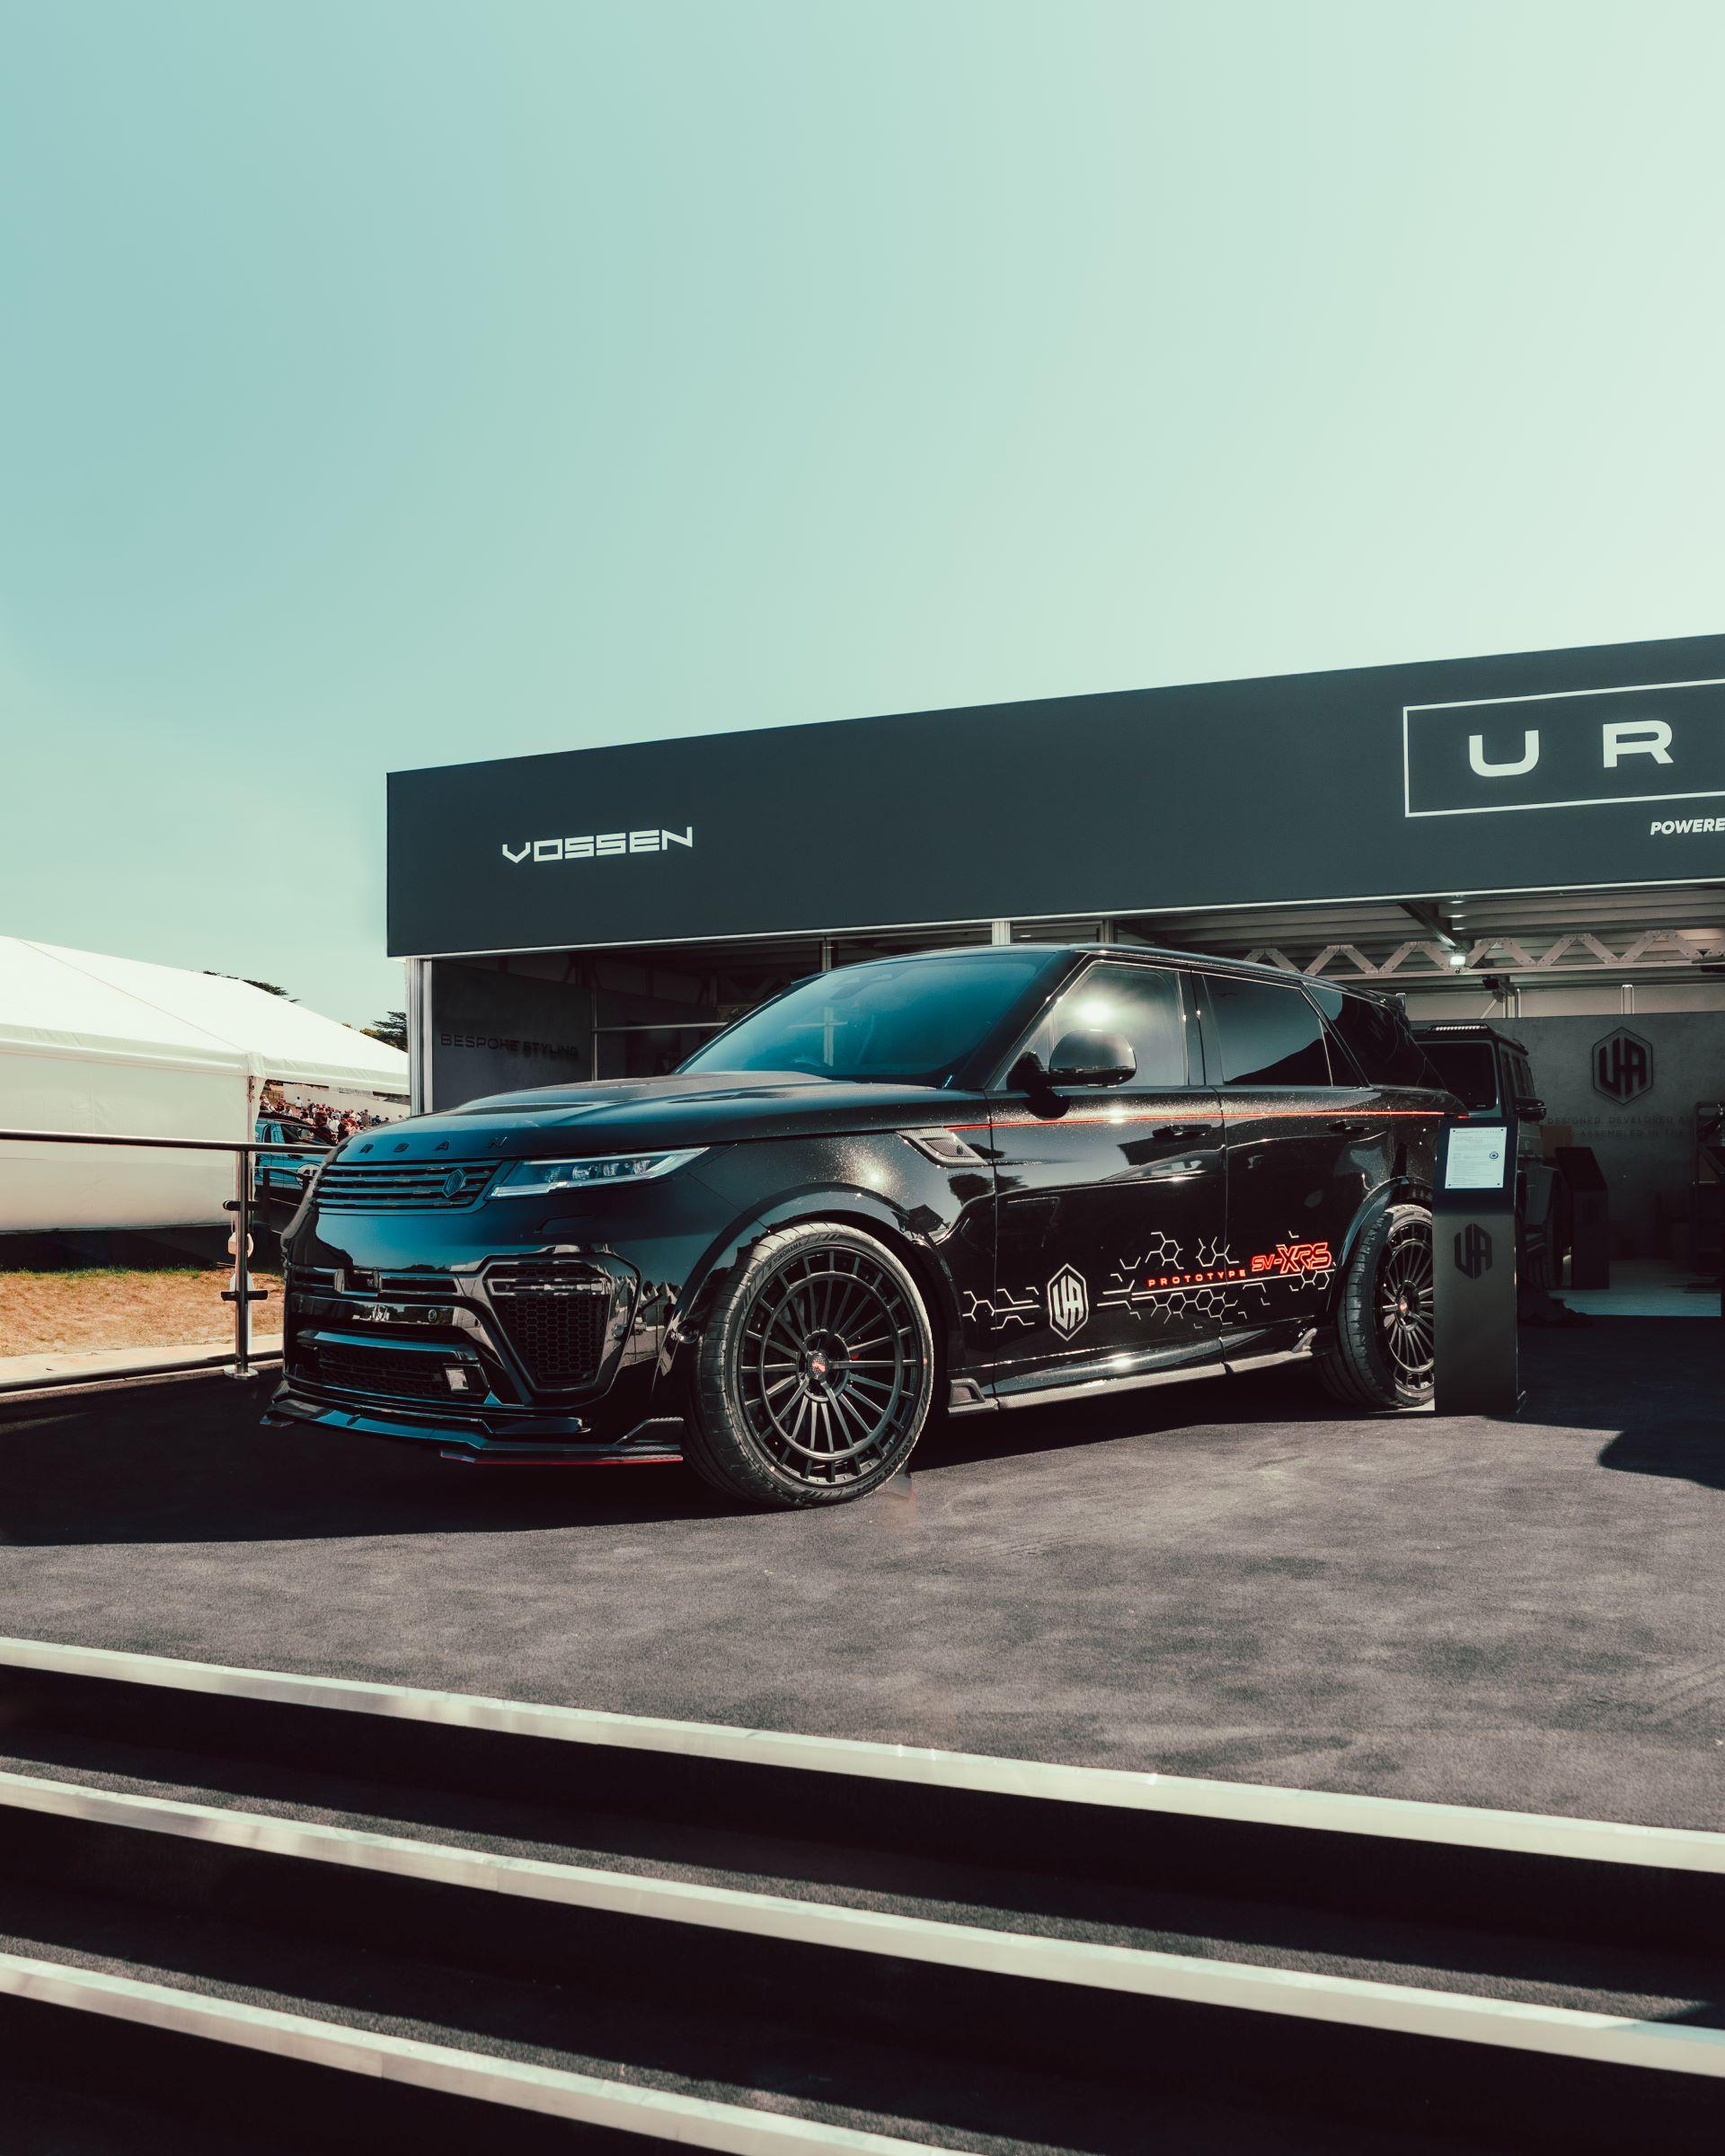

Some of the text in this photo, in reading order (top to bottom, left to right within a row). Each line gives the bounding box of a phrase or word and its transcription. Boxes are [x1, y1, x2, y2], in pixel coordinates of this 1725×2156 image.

[502, 826, 693, 863] VOSSEN
[440, 1033, 579, 1057] BESPOKE STYLING
[773, 1241, 803, 1263] YOKOHAMA
[1148, 1268, 1246, 1287] PROTOTYPE
